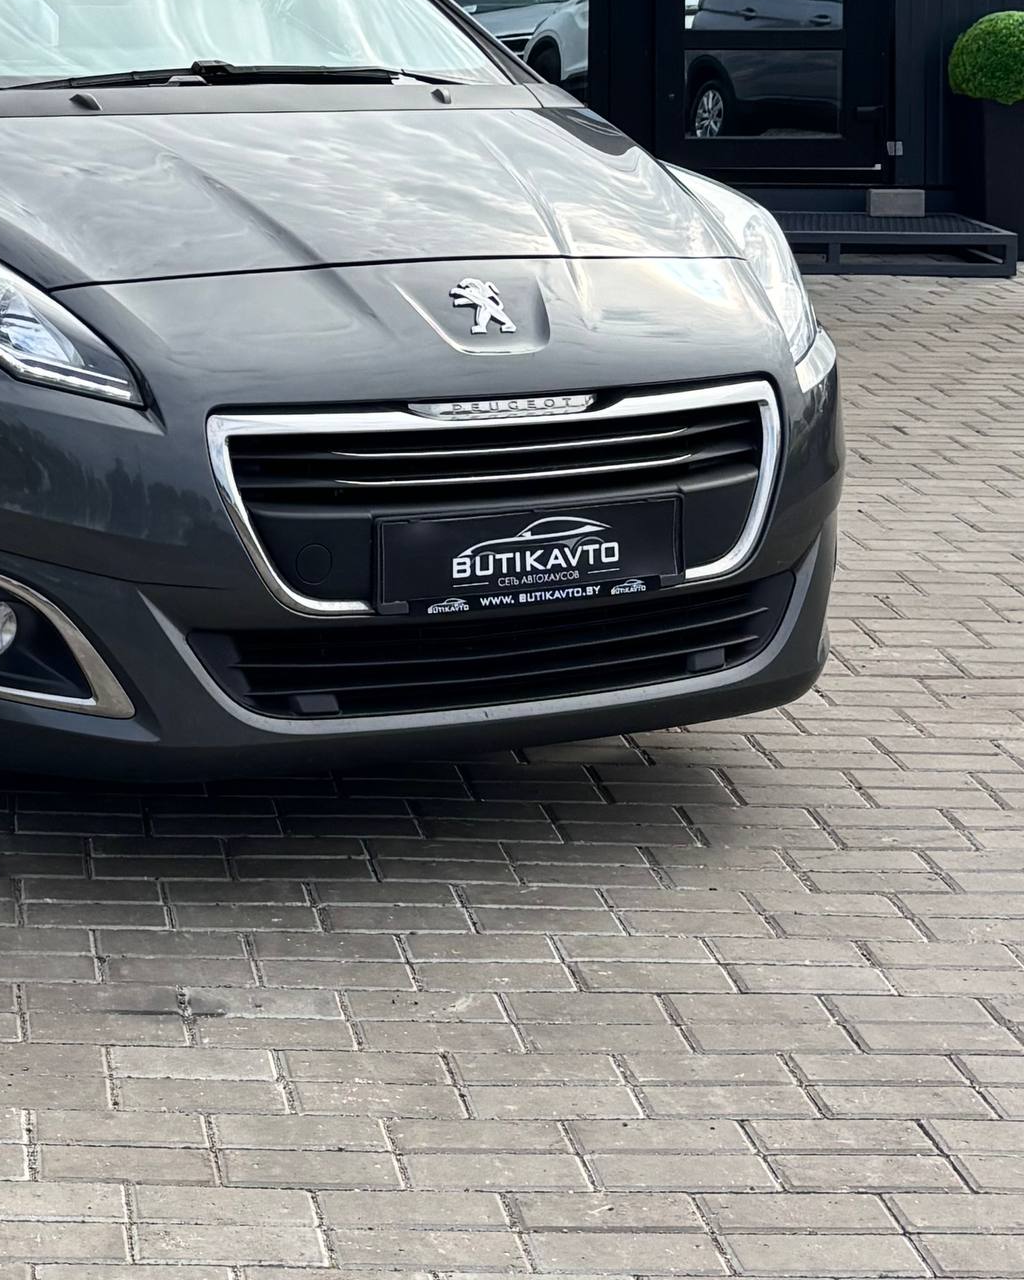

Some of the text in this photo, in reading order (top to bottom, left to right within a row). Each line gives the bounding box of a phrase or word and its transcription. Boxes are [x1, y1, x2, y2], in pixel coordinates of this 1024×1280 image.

[451, 397, 572, 412] PEUGEOT
[452, 541, 620, 579] BUTIKAVTO
[497, 570, 580, 587] СЕТЬ АВТОХАУСОВ
[519, 585, 601, 603] BUTIKAVTO.BY
